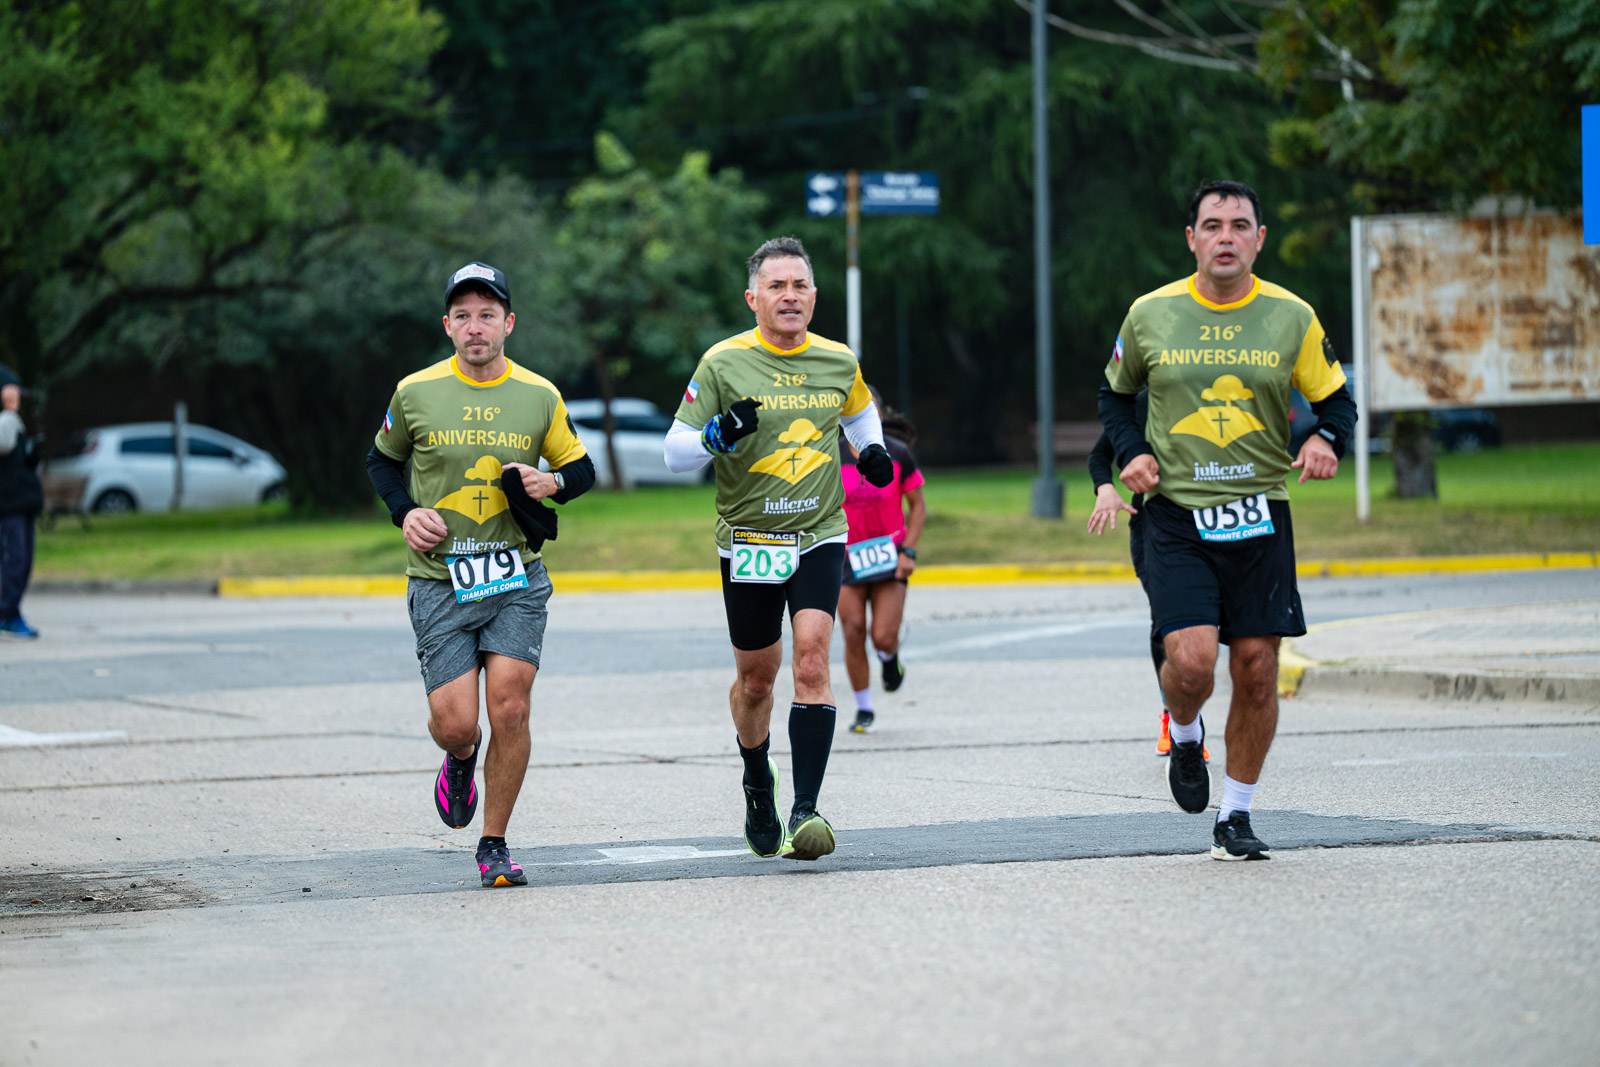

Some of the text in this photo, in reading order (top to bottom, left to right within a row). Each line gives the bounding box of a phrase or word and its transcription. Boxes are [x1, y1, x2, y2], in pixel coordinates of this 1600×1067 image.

[1159, 348, 1280, 368] ANIVERSARIO
[741, 393, 841, 411] NIVERSARIO
[428, 429, 532, 450] ANIVERSARIO
[1193, 461, 1255, 481] julicroc
[763, 496, 820, 514] julicroc
[1199, 495, 1262, 531] 058
[734, 531, 797, 540] CRONORACE
[1204, 526, 1269, 541] DIAMANTE CORRE
[449, 536, 509, 554] julicroc
[735, 548, 793, 578] 203
[855, 543, 891, 571] 105
[454, 549, 516, 590] 079
[461, 580, 524, 601] DIAMANTE CORRE
